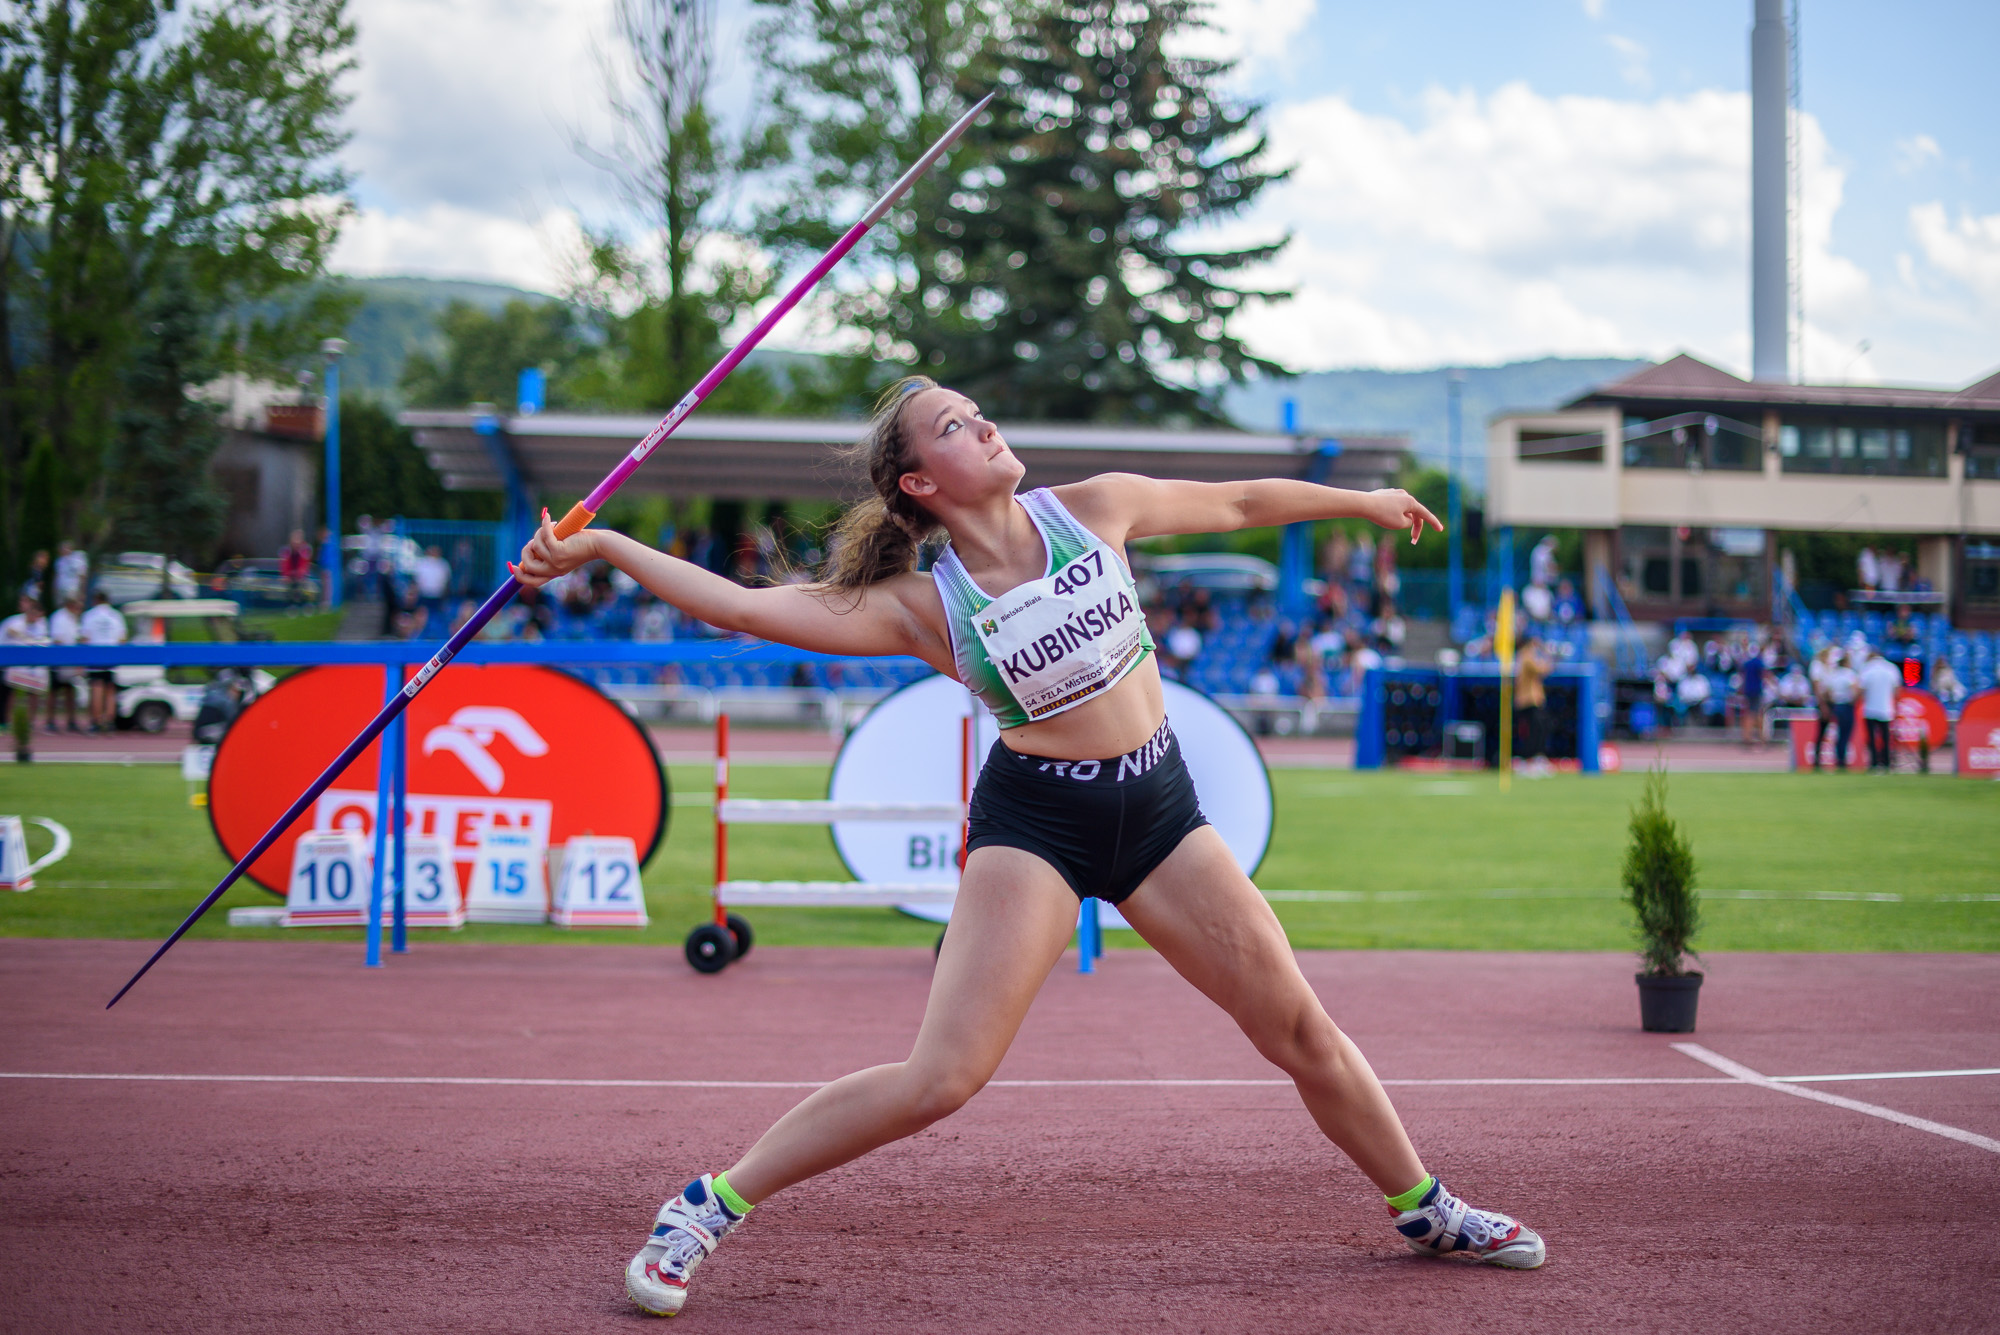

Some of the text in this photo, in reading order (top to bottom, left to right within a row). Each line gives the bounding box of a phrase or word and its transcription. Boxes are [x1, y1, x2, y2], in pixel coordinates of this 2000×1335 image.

[1054, 550, 1103, 595] 407
[1000, 595, 1042, 622] Bielsko-Biała
[1002, 591, 1133, 684] KUBIŃSKA
[1025, 698, 1040, 708] 54.
[1041, 687, 1064, 701] PZLA
[1116, 717, 1171, 782] NIKE
[299, 860, 353, 901] 10
[489, 860, 527, 895] 15
[579, 861, 632, 901] 12
